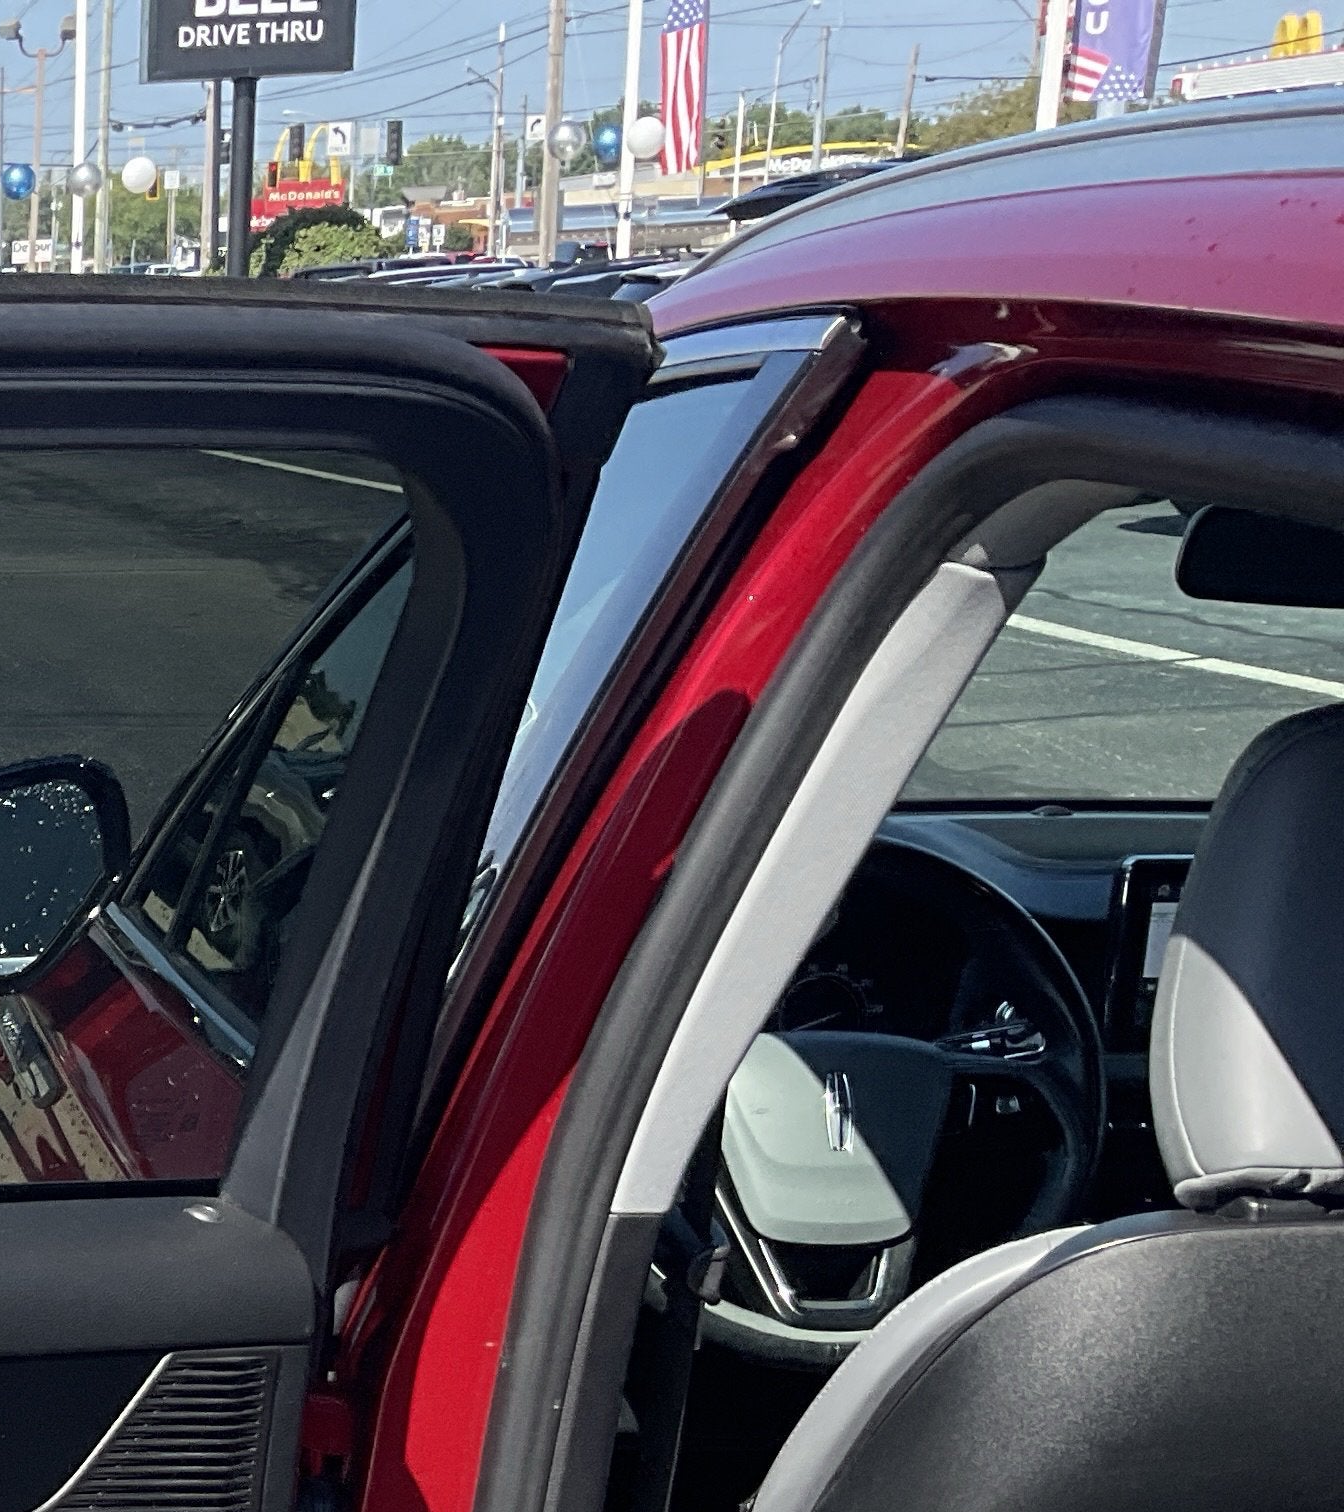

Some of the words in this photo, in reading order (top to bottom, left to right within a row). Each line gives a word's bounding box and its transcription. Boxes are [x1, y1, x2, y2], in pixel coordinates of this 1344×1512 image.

[178, 23, 251, 48] DRIVE
[256, 19, 324, 44] THRU
[268, 189, 341, 202] McDonald's
[13, 242, 51, 253] Deour
